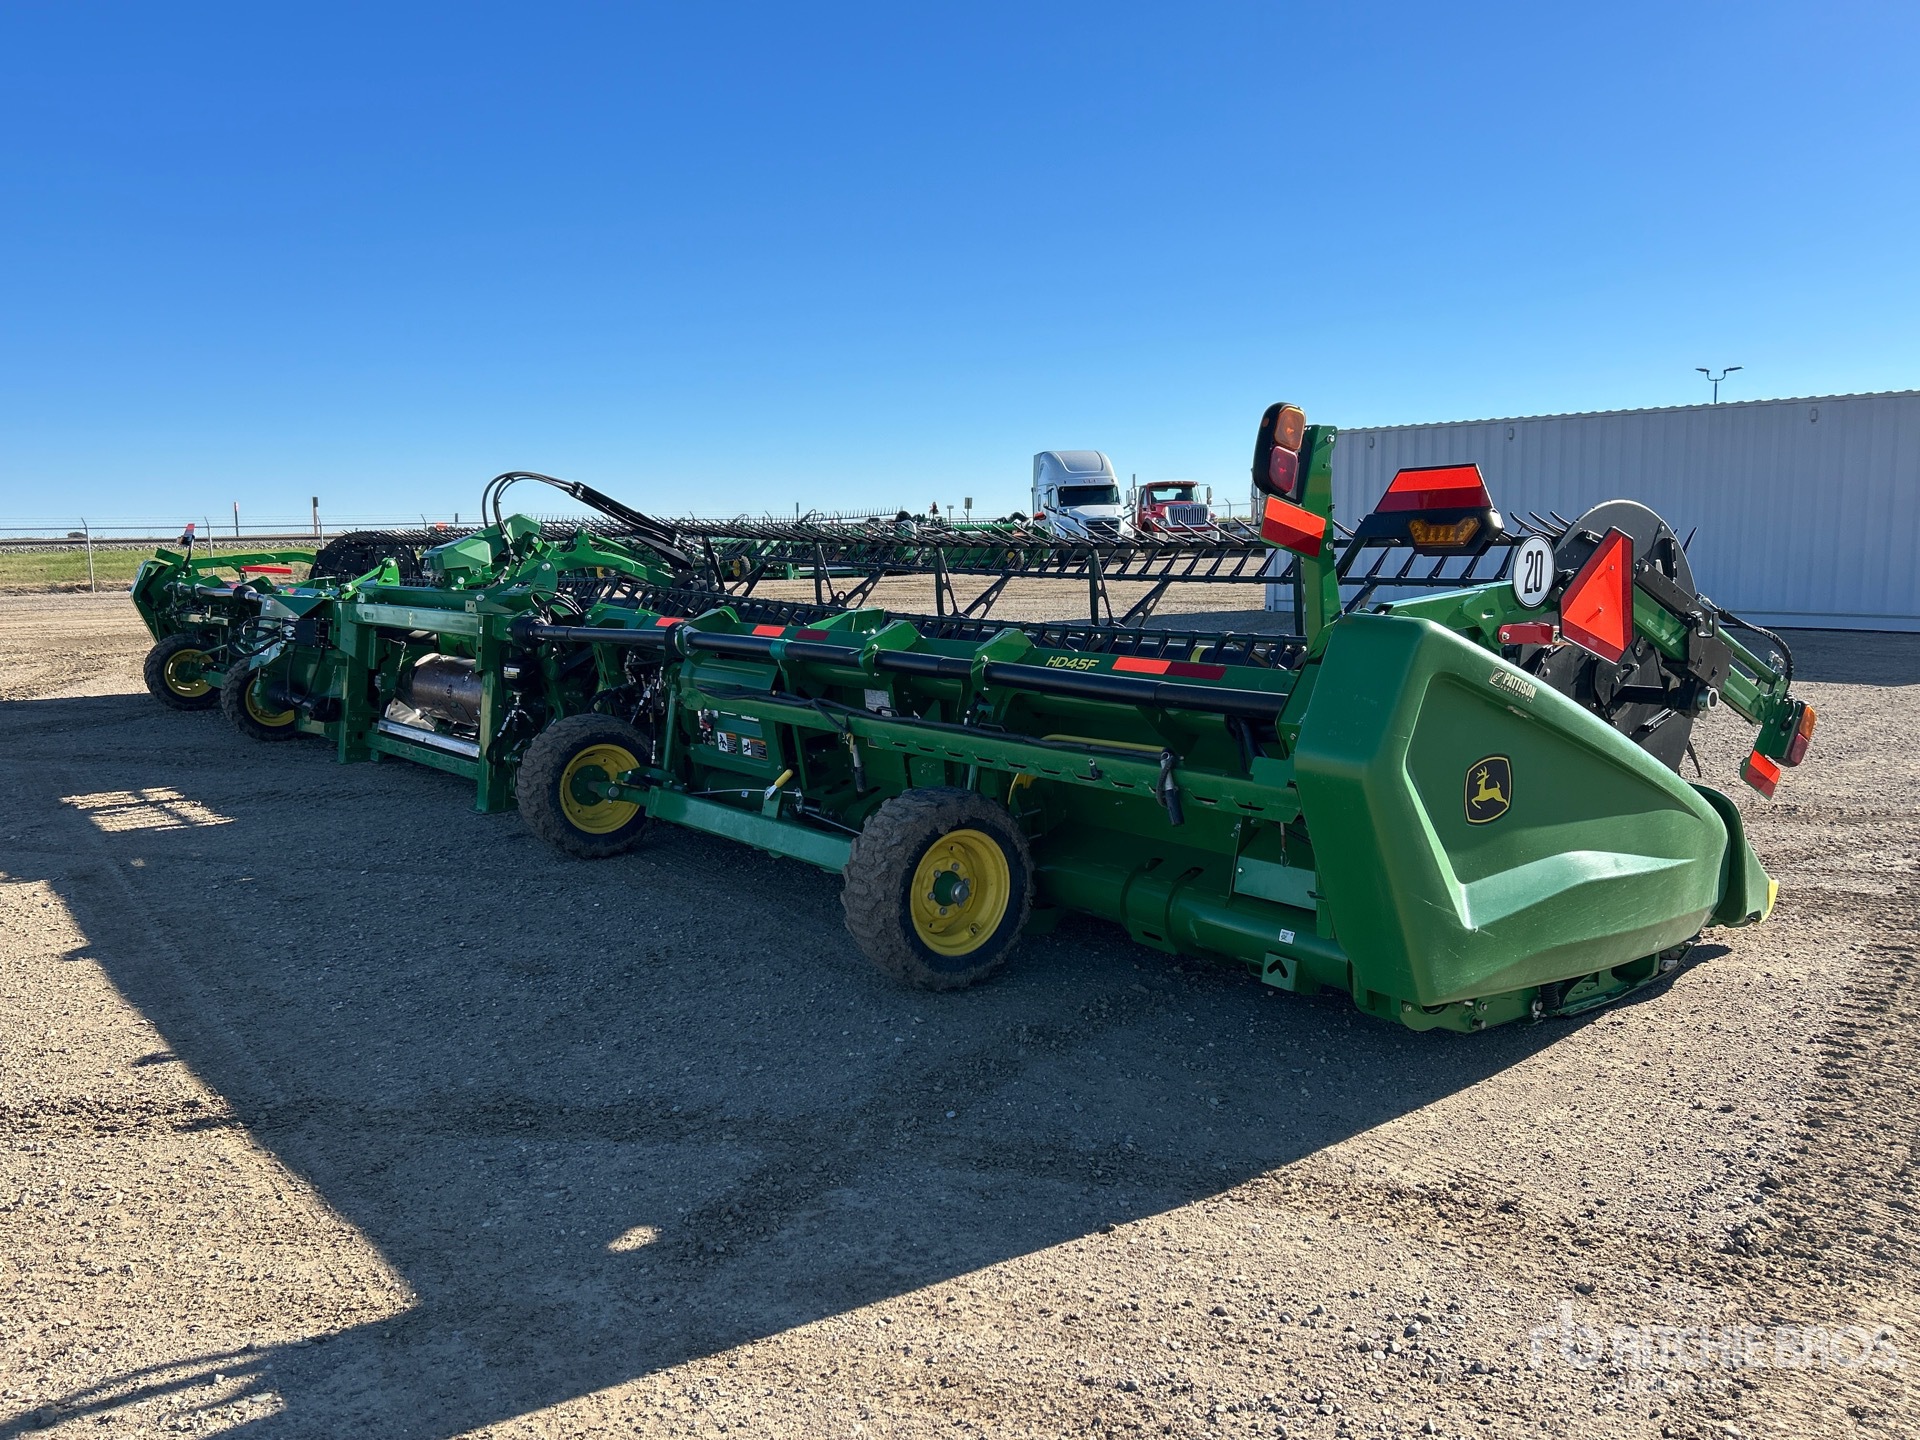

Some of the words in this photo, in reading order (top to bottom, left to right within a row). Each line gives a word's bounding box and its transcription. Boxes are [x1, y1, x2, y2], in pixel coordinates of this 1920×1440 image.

[1524, 550, 1544, 594] 20
[1045, 655, 1100, 671] HD45F
[1502, 672, 1538, 699] PATTISON
